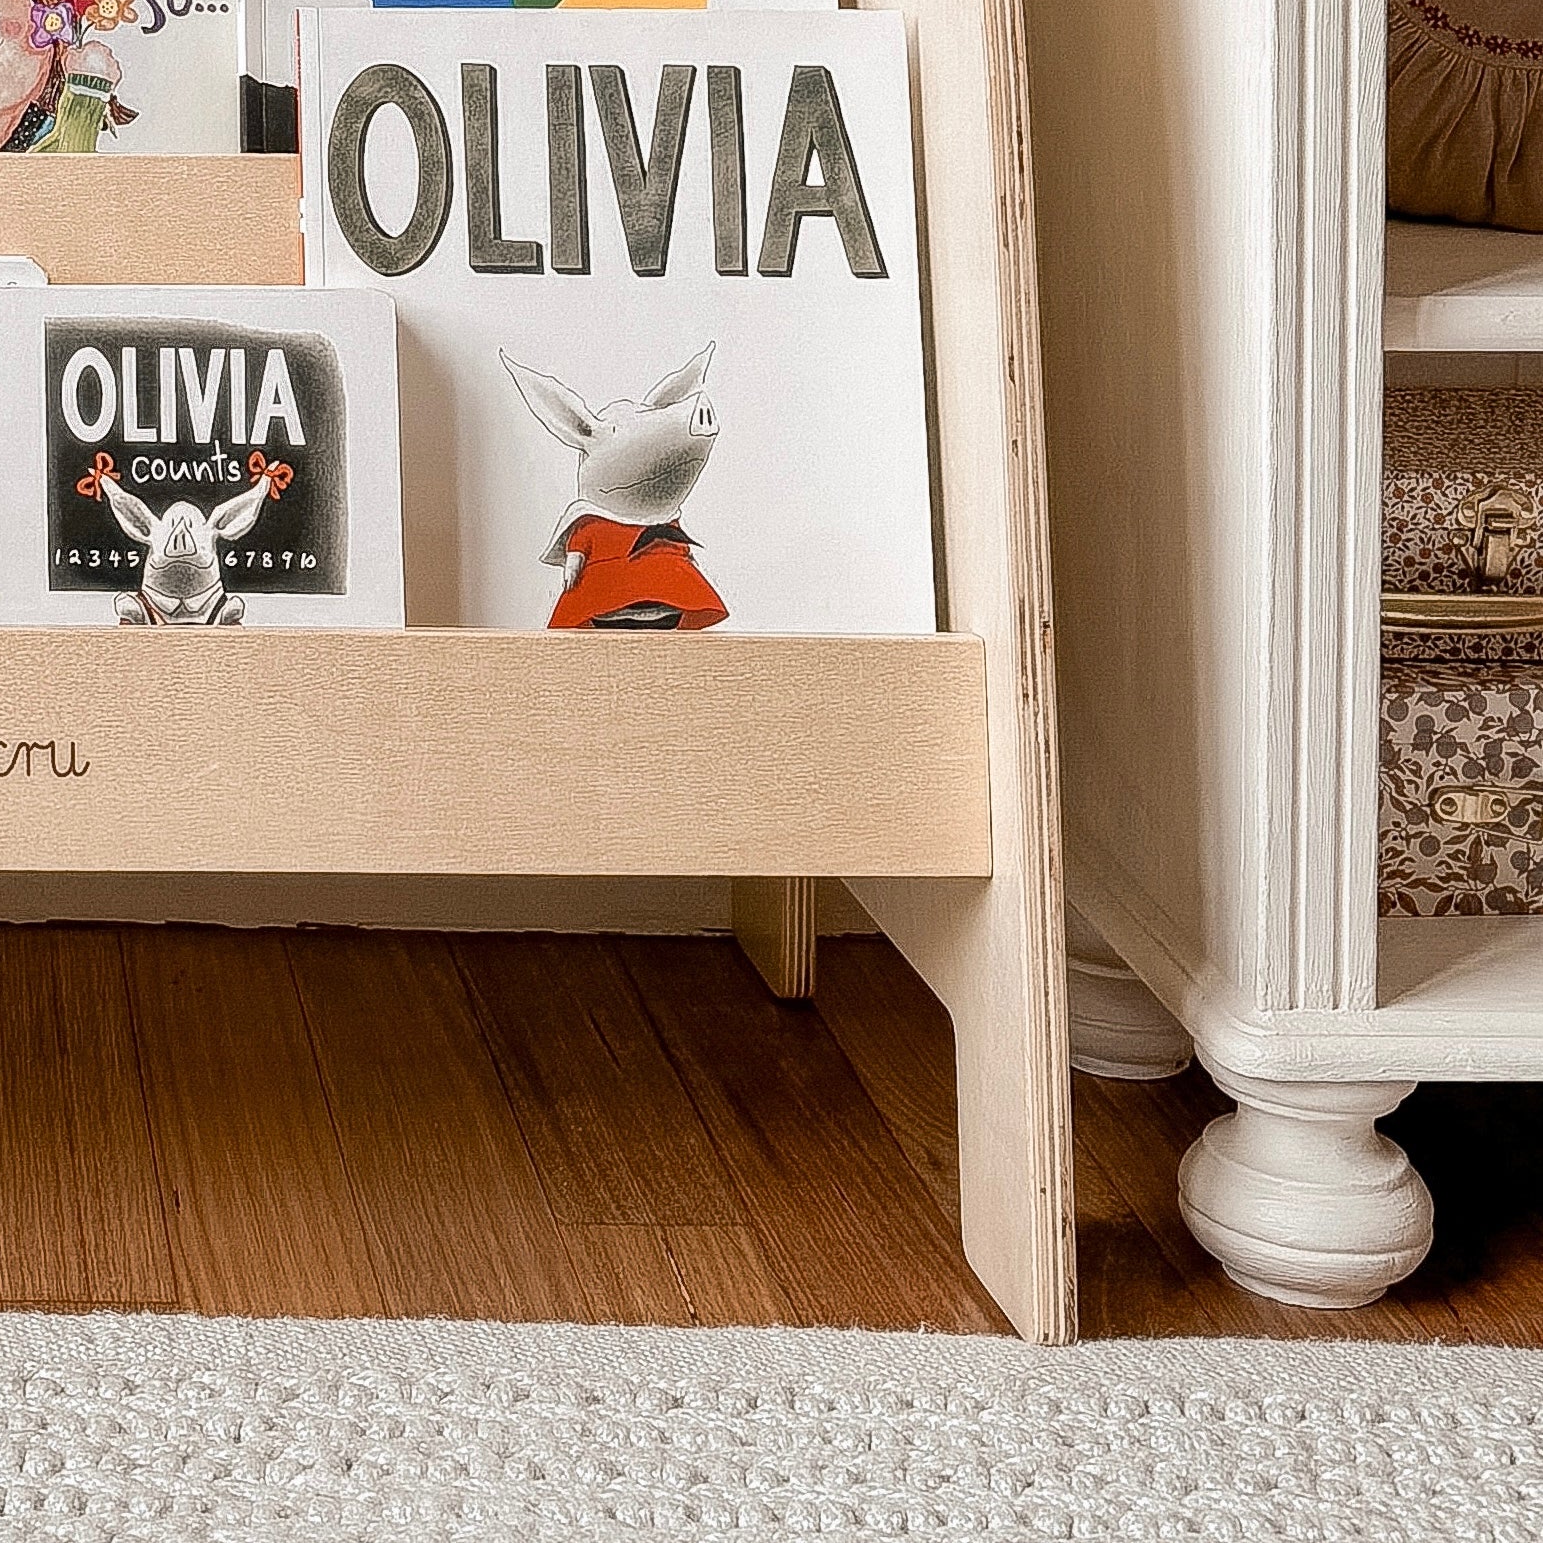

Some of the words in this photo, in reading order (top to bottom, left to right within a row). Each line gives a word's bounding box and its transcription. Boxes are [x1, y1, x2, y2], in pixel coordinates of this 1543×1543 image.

[327, 63, 890, 279] OLIVIA
[61, 346, 306, 446] OLIVIA
[131, 440, 242, 483] counts
[69, 549, 82, 565] 2
[88, 550, 101, 566] 3
[108, 549, 122, 567] 4
[125, 550, 140, 567] 5
[225, 550, 238, 567] 6
[245, 551, 256, 568] 7
[262, 551, 274, 569] 8
[282, 551, 294, 570] 9
[300, 552, 317, 569] 10
